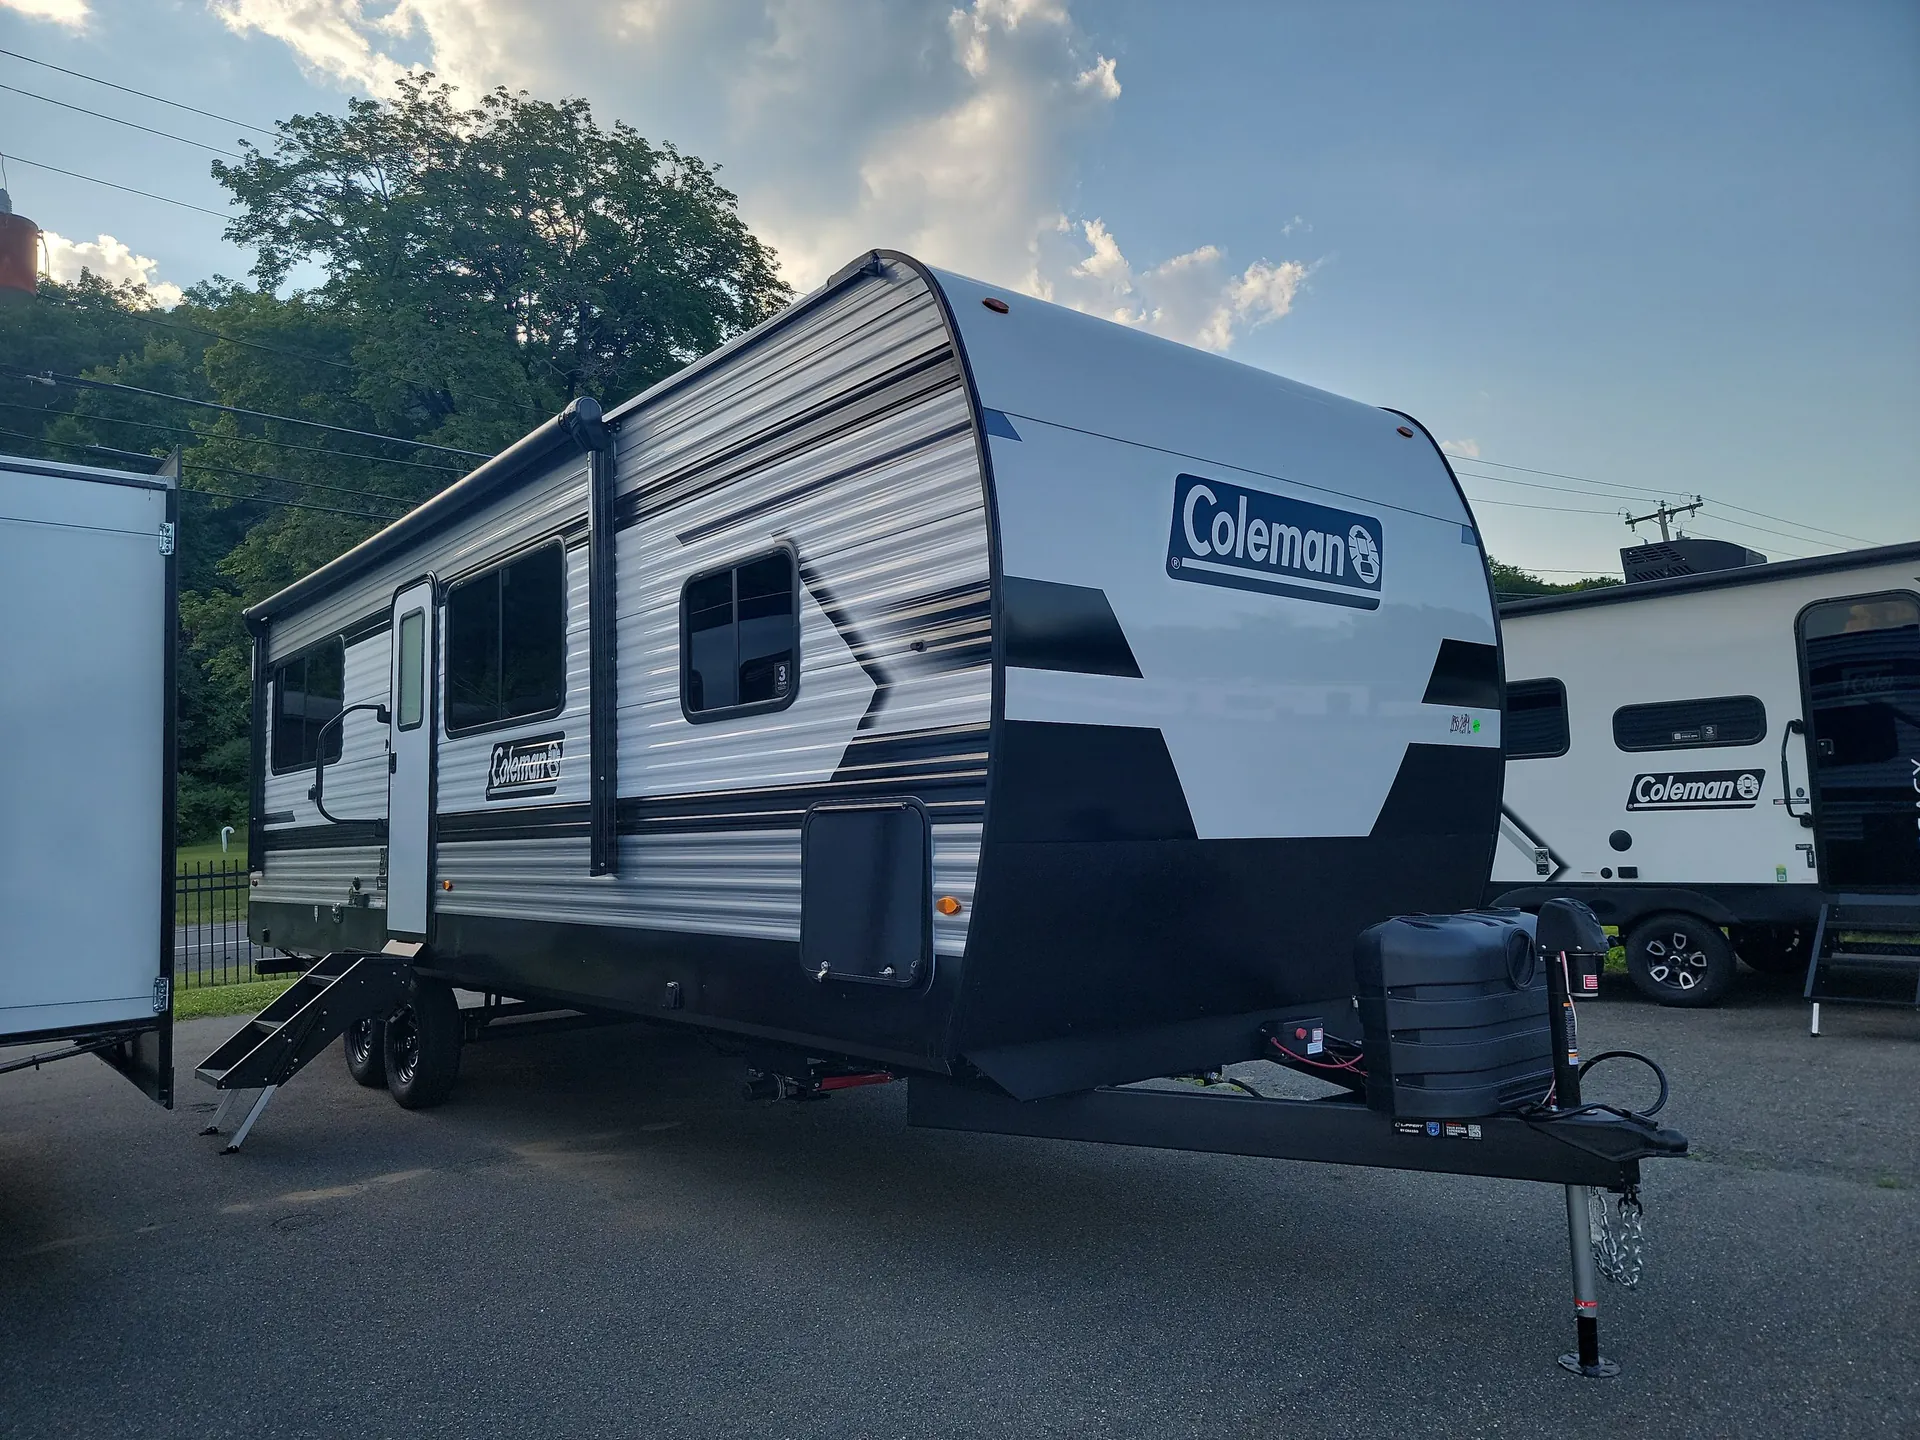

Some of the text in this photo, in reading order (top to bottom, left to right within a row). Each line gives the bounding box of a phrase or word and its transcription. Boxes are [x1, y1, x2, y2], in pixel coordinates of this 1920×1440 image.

[1183, 484, 1345, 577] Coleman
[778, 665, 786, 681] 3
[1706, 726, 1714, 735] 3
[492, 745, 547, 787] Coleman
[1635, 775, 1735, 803] Coleman
